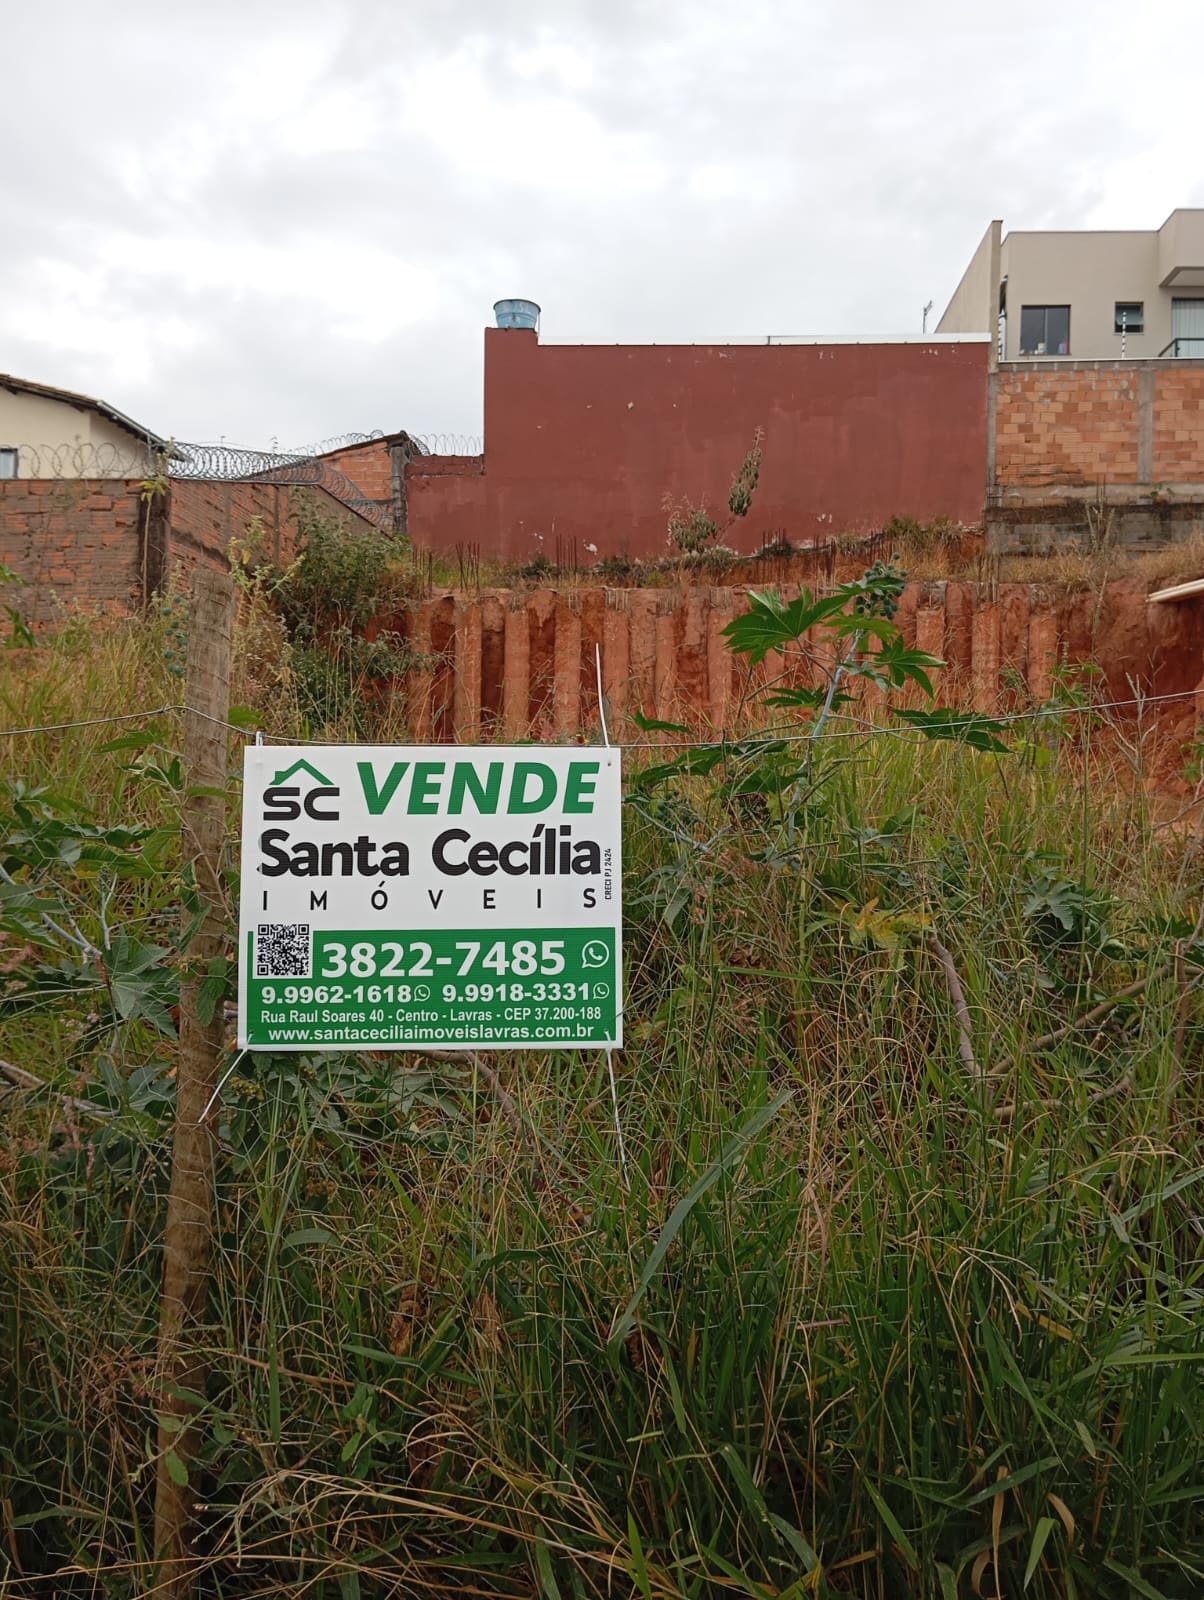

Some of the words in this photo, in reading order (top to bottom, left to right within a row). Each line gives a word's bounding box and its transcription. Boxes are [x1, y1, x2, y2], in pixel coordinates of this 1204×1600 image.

[356, 762, 600, 815] VENDE
[263, 787, 340, 821] SC
[258, 828, 410, 877] Santa
[431, 823, 601, 877] Cecília
[604, 848, 612, 867] 2424
[604, 868, 612, 878] PJ
[604, 879, 612, 900] CRECI
[321, 940, 566, 978] 3822-7485
[261, 984, 412, 1004] 9.9962-1618
[442, 982, 589, 1002] 9.9918-3331
[261, 1010, 286, 1023] Rua
[290, 1010, 318, 1023] Raul
[321, 1009, 366, 1023] Soares
[369, 1009, 384, 1022] 40
[396, 1008, 439, 1022] Centro
[450, 1008, 493, 1021] Lavras
[504, 1007, 531, 1020] CEP
[534, 1006, 601, 1020] 37.200-188
[268, 1023, 594, 1041] www.santaceciliaimoveislavras.com.br
